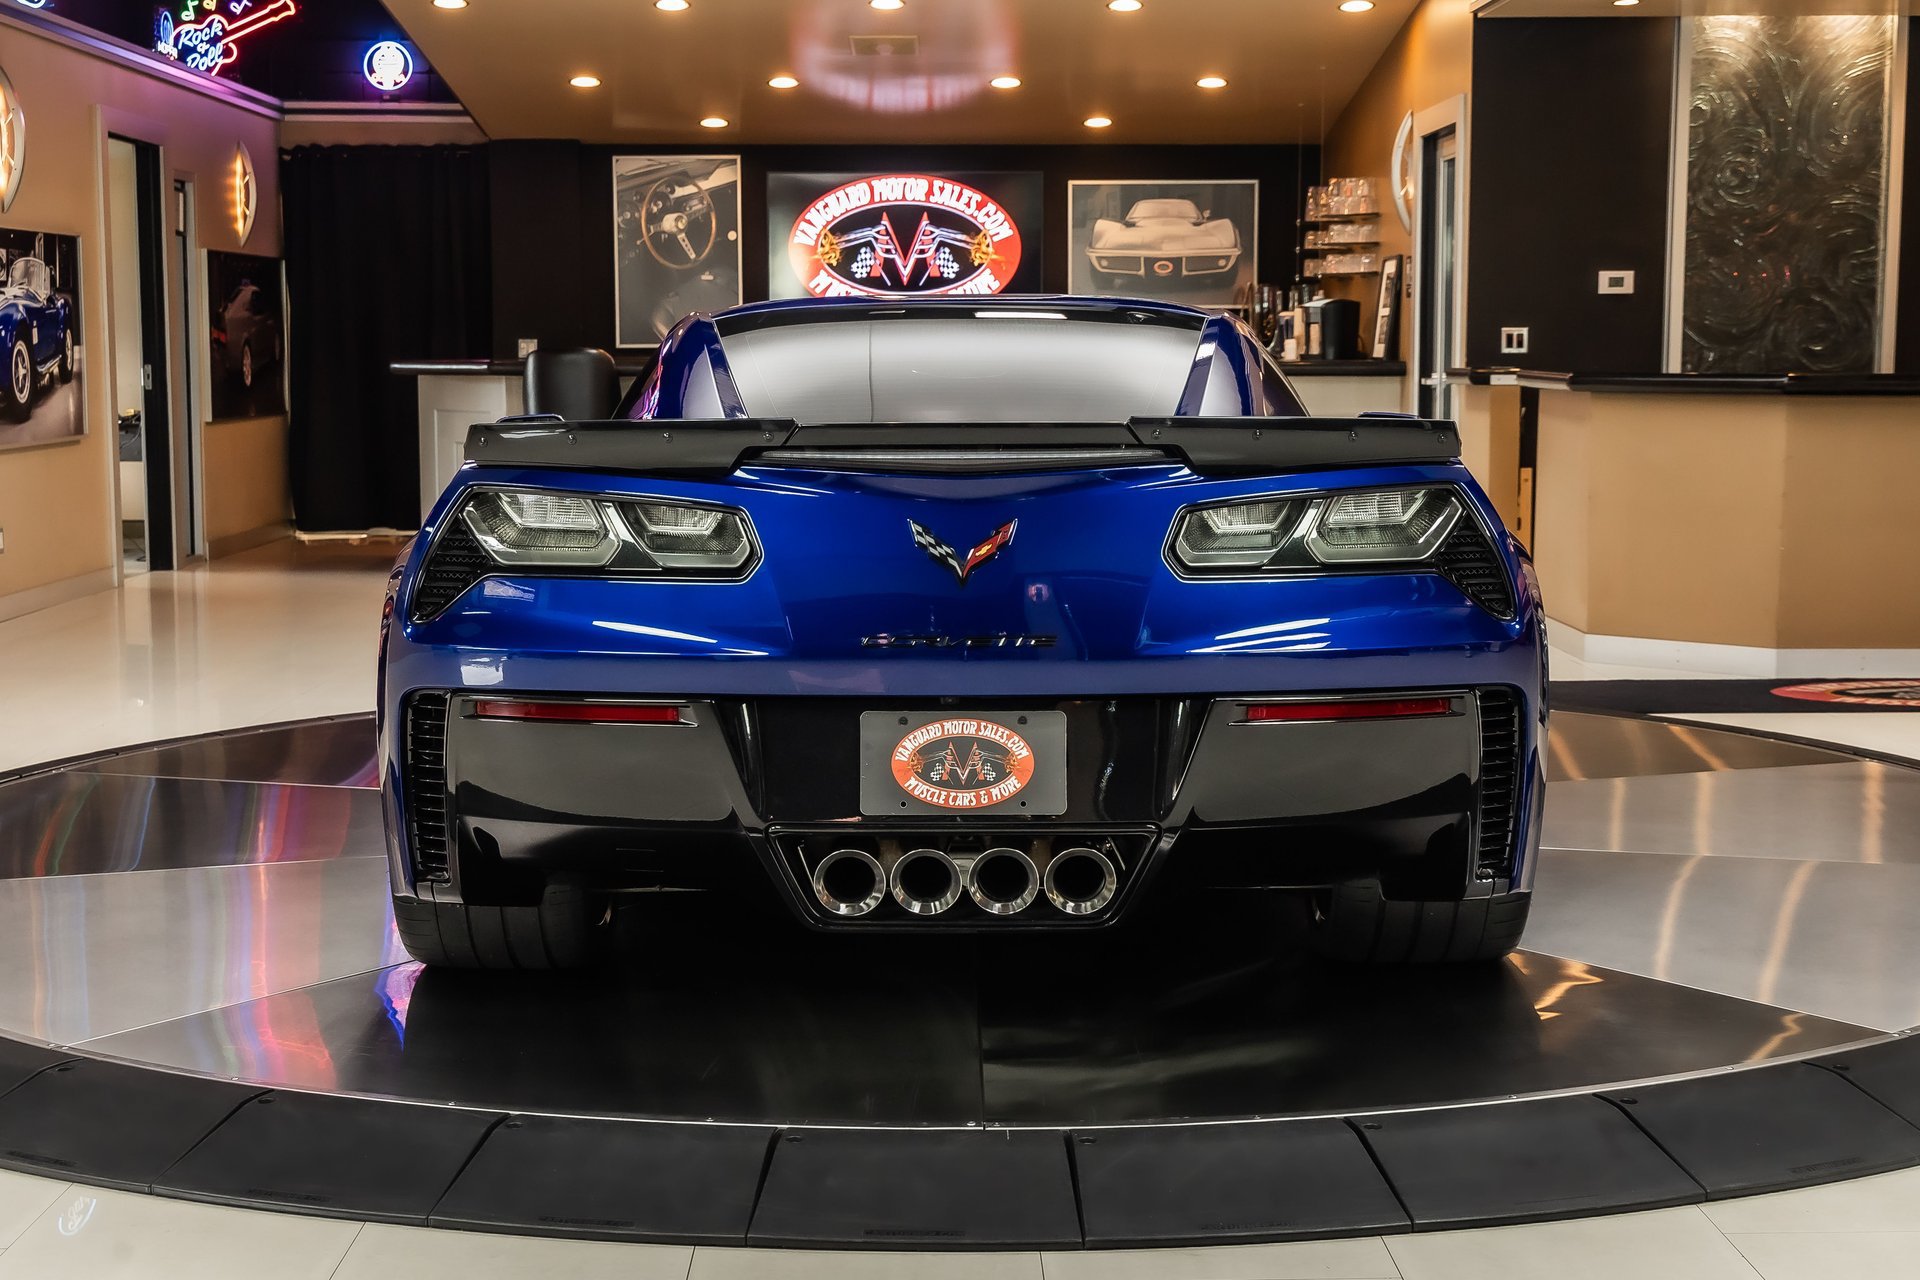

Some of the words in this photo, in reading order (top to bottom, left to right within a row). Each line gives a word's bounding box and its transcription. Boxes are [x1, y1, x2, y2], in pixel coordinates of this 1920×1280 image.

[178, 18, 223, 50] Rock
[793, 182, 871, 246] VANGUARD
[871, 177, 929, 202] MOTOR
[929, 179, 1014, 242] SALES.COM
[895, 723, 943, 762] VANGUARD
[943, 720, 978, 735] MOTOR
[979, 722, 1030, 759] SALES.COM
[904, 776, 948, 804] MUSCLE
[948, 792, 977, 806] CARS
[979, 790, 988, 804] &
[989, 775, 1022, 801] MORE
